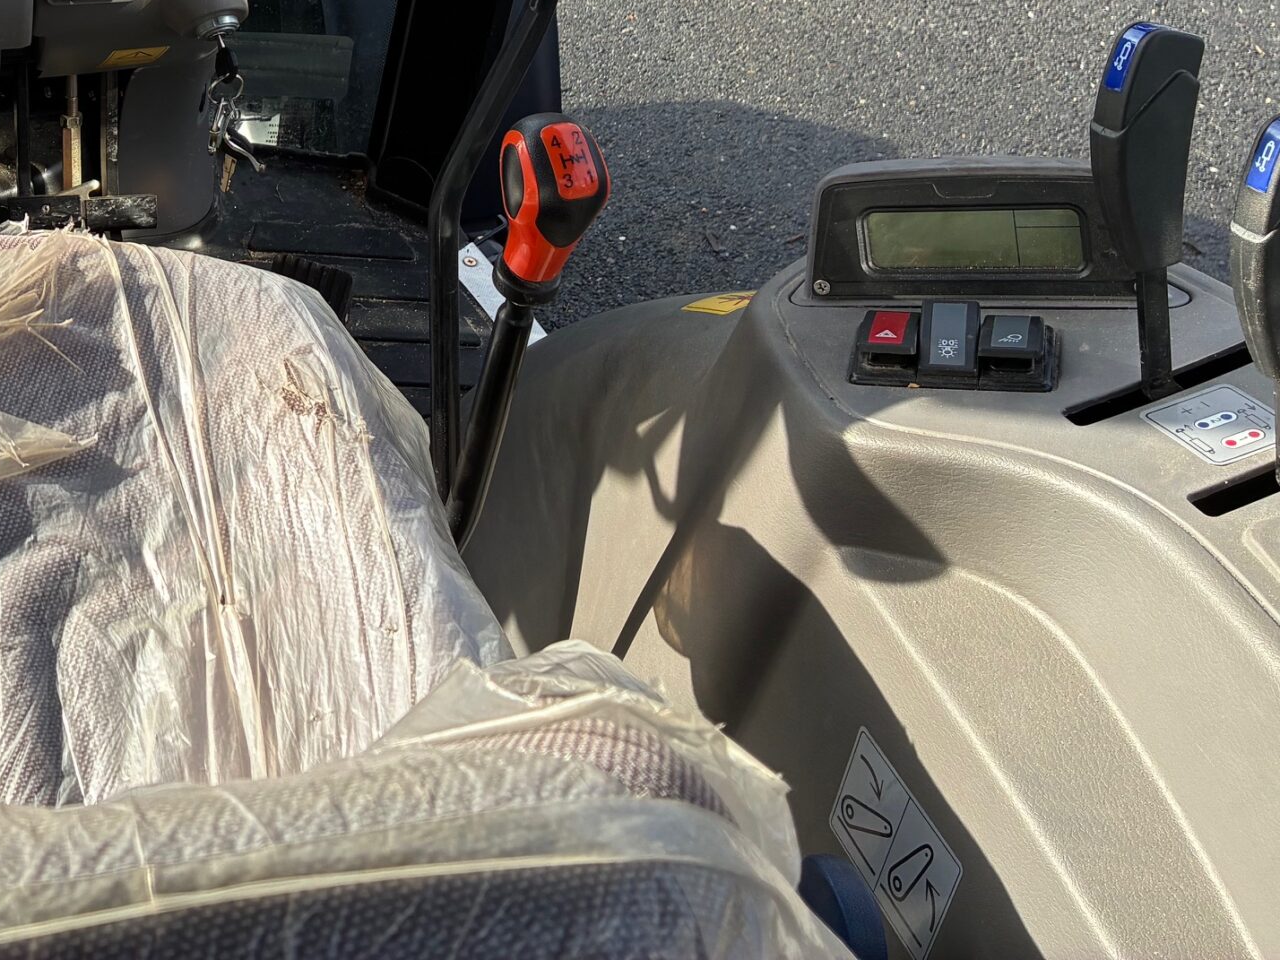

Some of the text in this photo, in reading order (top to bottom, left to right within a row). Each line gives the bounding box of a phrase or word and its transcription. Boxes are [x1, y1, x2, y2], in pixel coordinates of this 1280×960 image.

[551, 131, 583, 148] 4 2
[563, 170, 595, 188] 3 1
